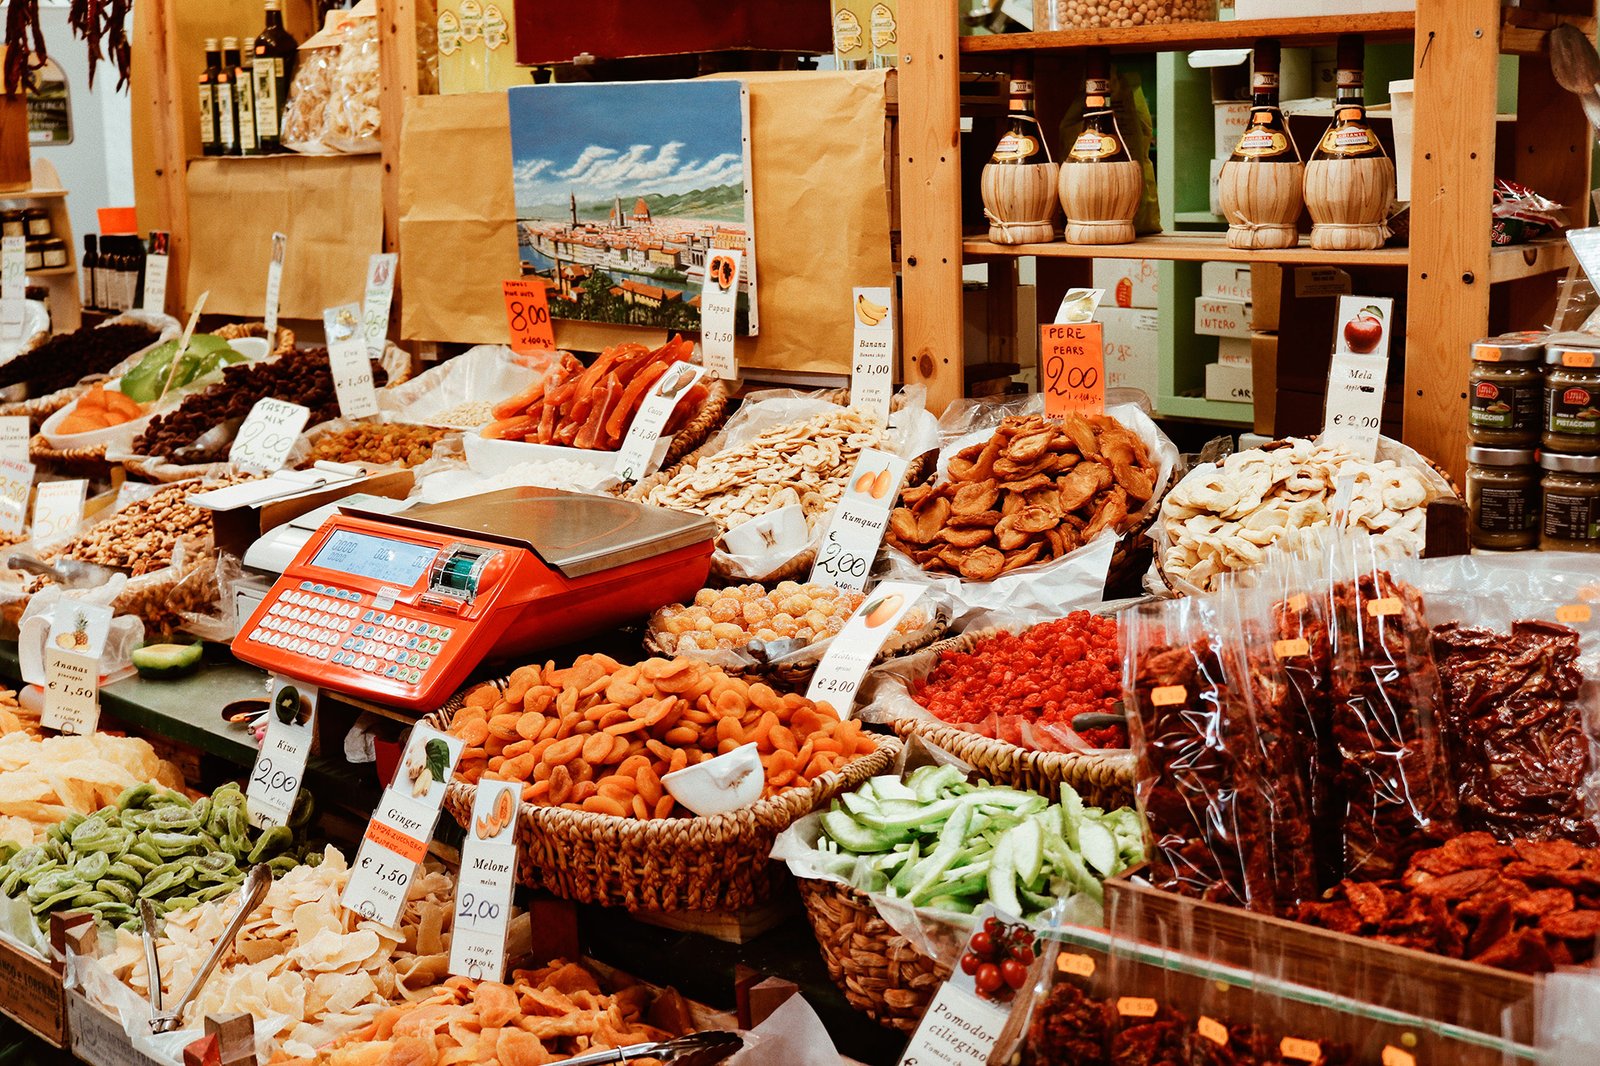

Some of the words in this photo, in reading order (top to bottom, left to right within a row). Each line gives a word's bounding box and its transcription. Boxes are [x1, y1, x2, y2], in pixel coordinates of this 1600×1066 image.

[708, 303, 730, 314] Papaya
[714, 332, 733, 342] 1,50
[1049, 327, 1086, 340] PERE
[859, 340, 887, 348] Banana
[1053, 345, 1085, 356] PEARS
[856, 364, 863, 374] €
[867, 364, 890, 376] 1,00
[1348, 369, 1373, 380] Mela
[348, 374, 371, 388] 1,50
[1231, 387, 1251, 399] CAR
[260, 401, 299, 417] TASTY
[1333, 414, 1343, 425] €
[1471, 412, 1504, 422] PISTACCHIO
[1556, 419, 1596, 428] PISTACCHIO
[842, 512, 882, 528] Kumquat
[829, 530, 837, 542] €
[817, 542, 866, 578] 2,00
[53, 660, 88, 674] Ananas
[57, 672, 83, 682] pineapple
[48, 681, 58, 690] €
[64, 684, 93, 698] 1,50
[818, 678, 826, 688] €
[828, 680, 855, 693] 2,00
[276, 740, 297, 754] Kiwi
[254, 758, 298, 794] 2,00
[388, 808, 422, 830] Ginger
[362, 856, 372, 869] €
[375, 864, 408, 886] 1,50
[472, 858, 509, 872] Melone
[378, 888, 390, 898] 100
[458, 892, 500, 926] 2,00
[929, 1025, 987, 1062] ciliegino
[923, 1040, 952, 1062] Tomato
